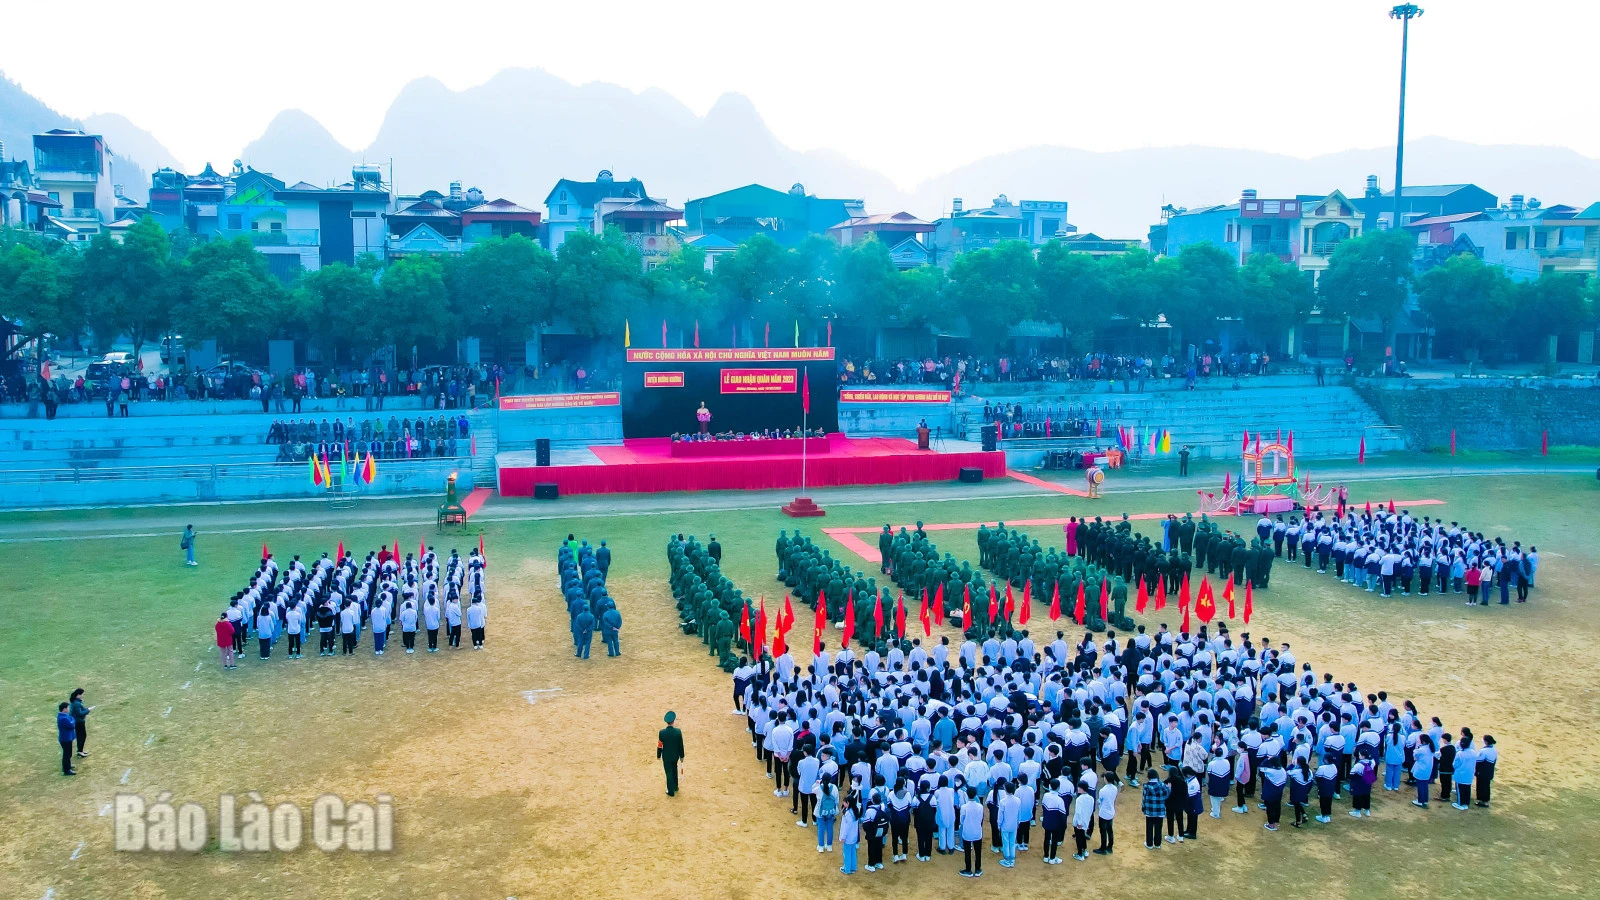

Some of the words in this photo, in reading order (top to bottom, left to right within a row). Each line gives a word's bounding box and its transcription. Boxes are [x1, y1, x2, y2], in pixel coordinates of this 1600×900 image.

[633, 351, 654, 360] NƯỚC
[655, 351, 675, 360] CỘNG
[677, 351, 691, 360] HÒA
[693, 350, 703, 359] XÃ
[704, 351, 717, 360] HỘI
[718, 349, 733, 359] CHỦ
[734, 350, 756, 359] NGHĨA
[757, 350, 772, 359] VIỆT
[773, 351, 789, 359] NAM
[791, 350, 812, 358] MUÔN
[813, 349, 829, 358] NĂM
[730, 375, 742, 384] GIAO
[742, 374, 756, 385] NHẬN
[756, 374, 770, 384] QUÂN
[770, 373, 782, 384] NĂM
